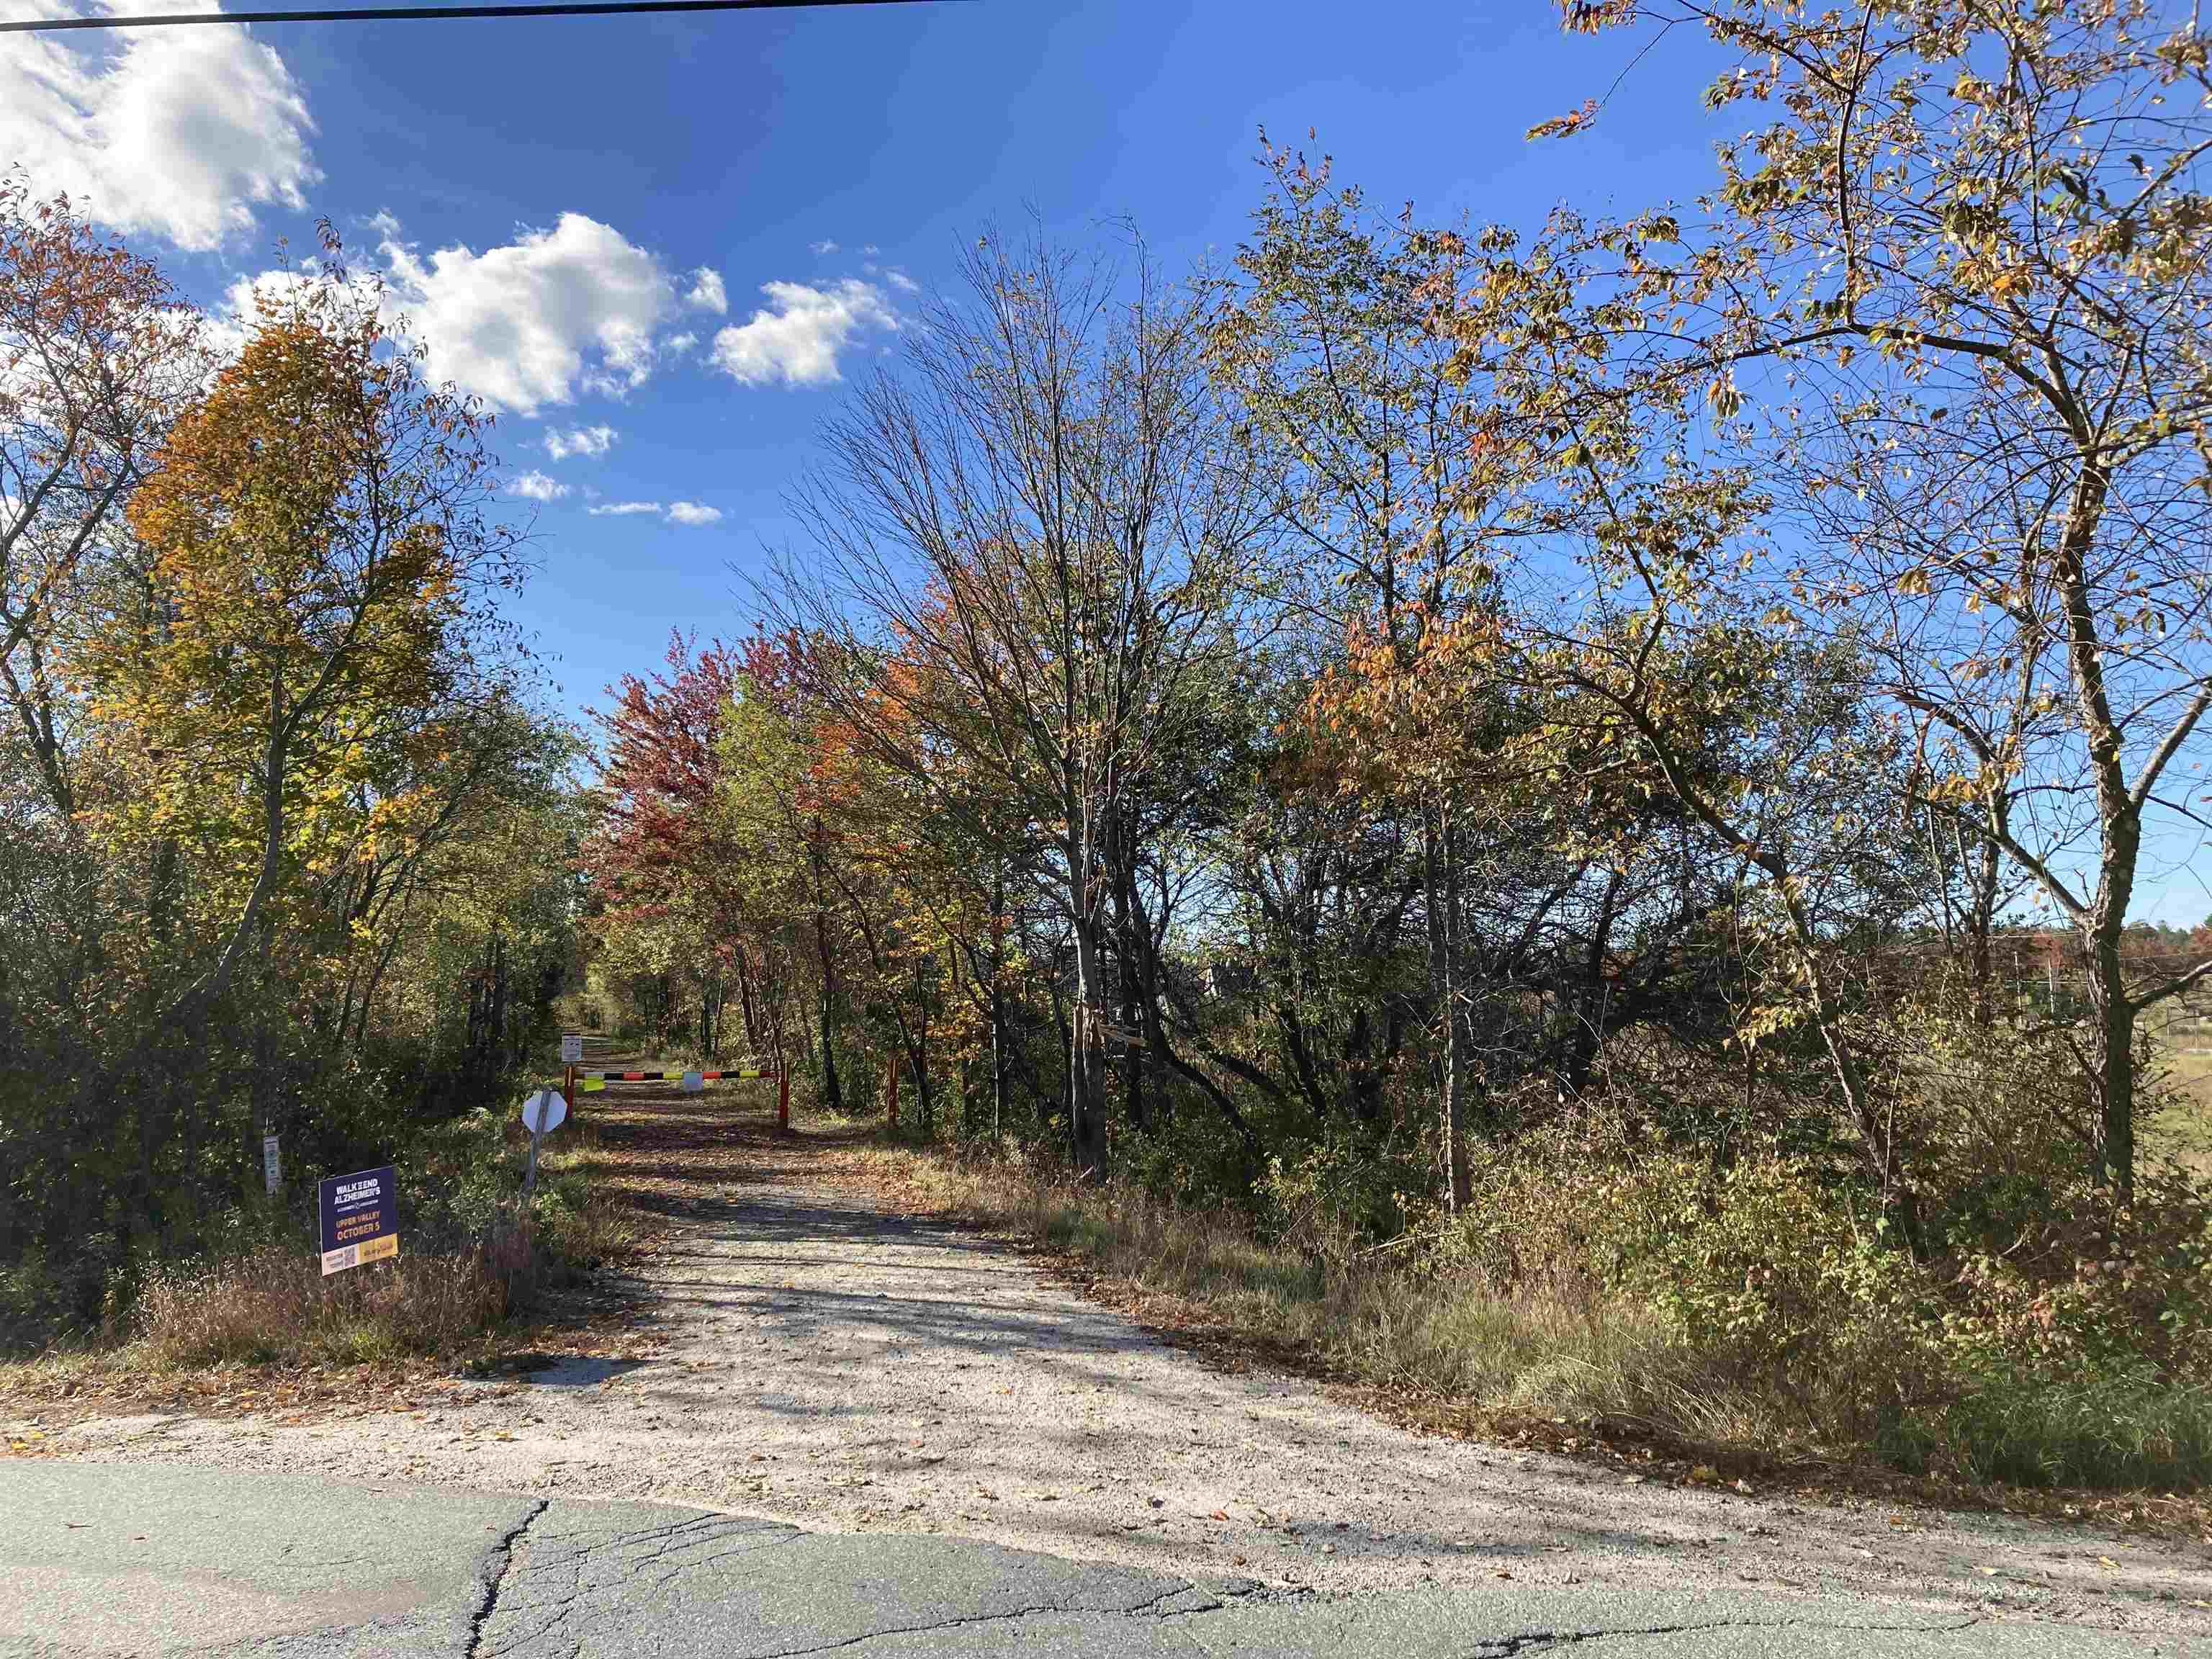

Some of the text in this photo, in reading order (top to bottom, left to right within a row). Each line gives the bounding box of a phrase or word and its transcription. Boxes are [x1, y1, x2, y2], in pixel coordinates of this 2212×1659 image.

[336, 1183, 357, 1195] WALK
[364, 1179, 378, 1188] END
[336, 1211, 380, 1228] UPPER VALLEY
[337, 1223, 374, 1240] OCTOBER
